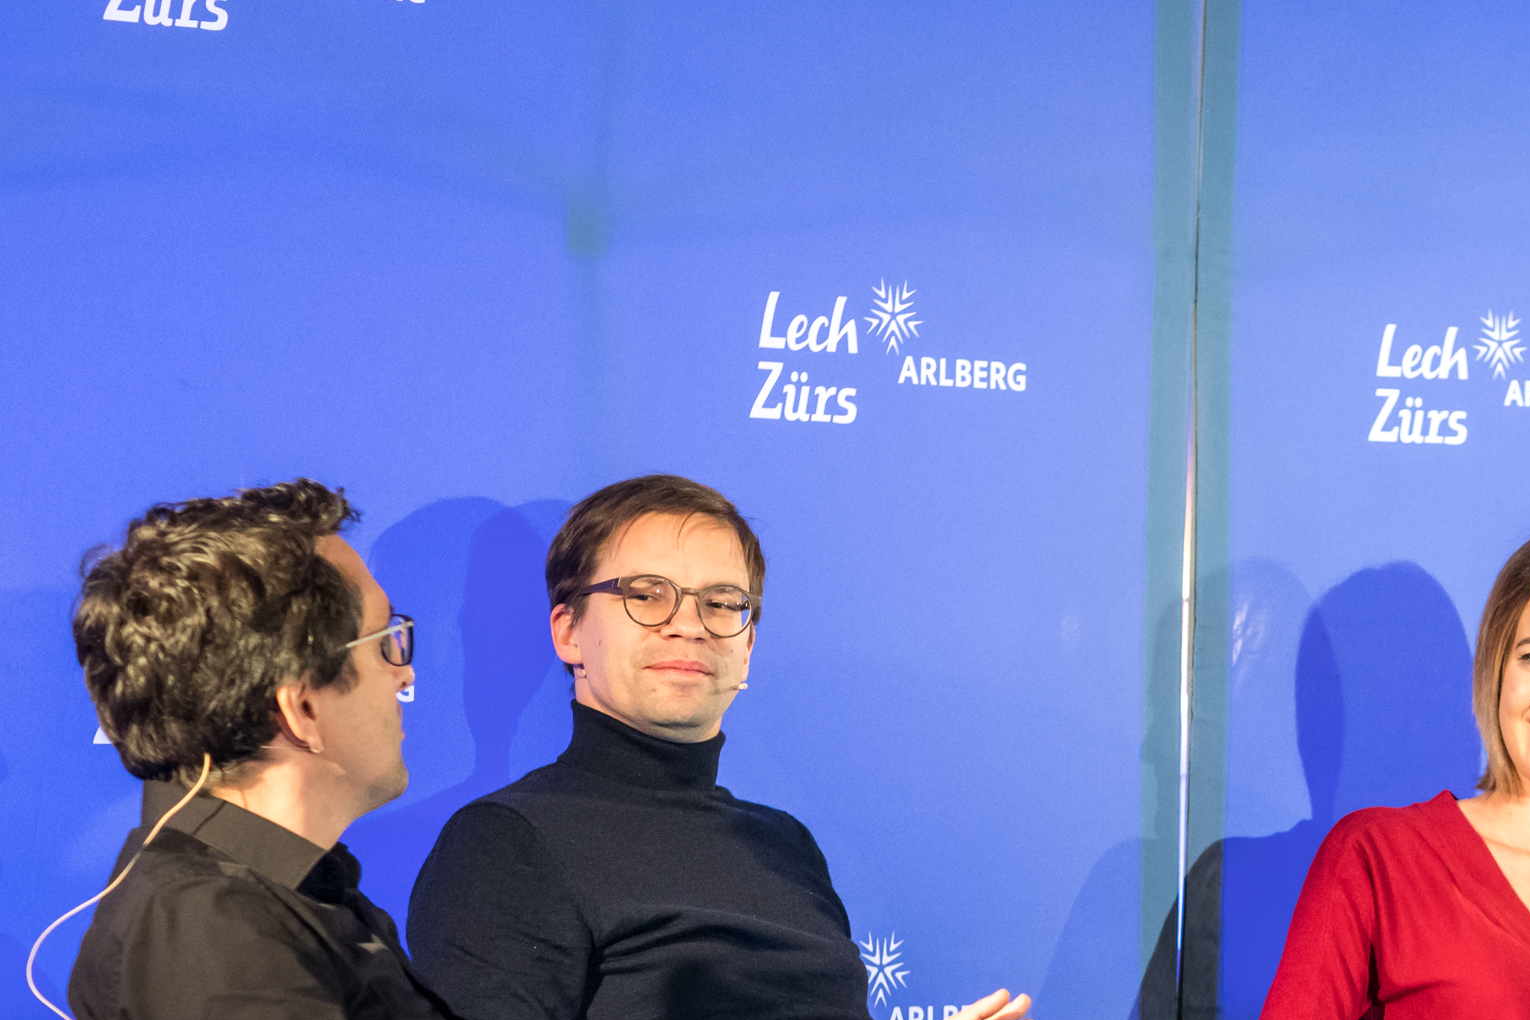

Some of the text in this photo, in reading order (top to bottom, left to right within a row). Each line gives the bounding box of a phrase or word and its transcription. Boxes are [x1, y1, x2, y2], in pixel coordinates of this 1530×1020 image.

[758, 291, 859, 354] Lech
[898, 355, 1027, 392] ARLBERG
[1376, 323, 1469, 380] Lech
[749, 361, 858, 425] Zürs
[1368, 388, 1468, 445] Zürs
